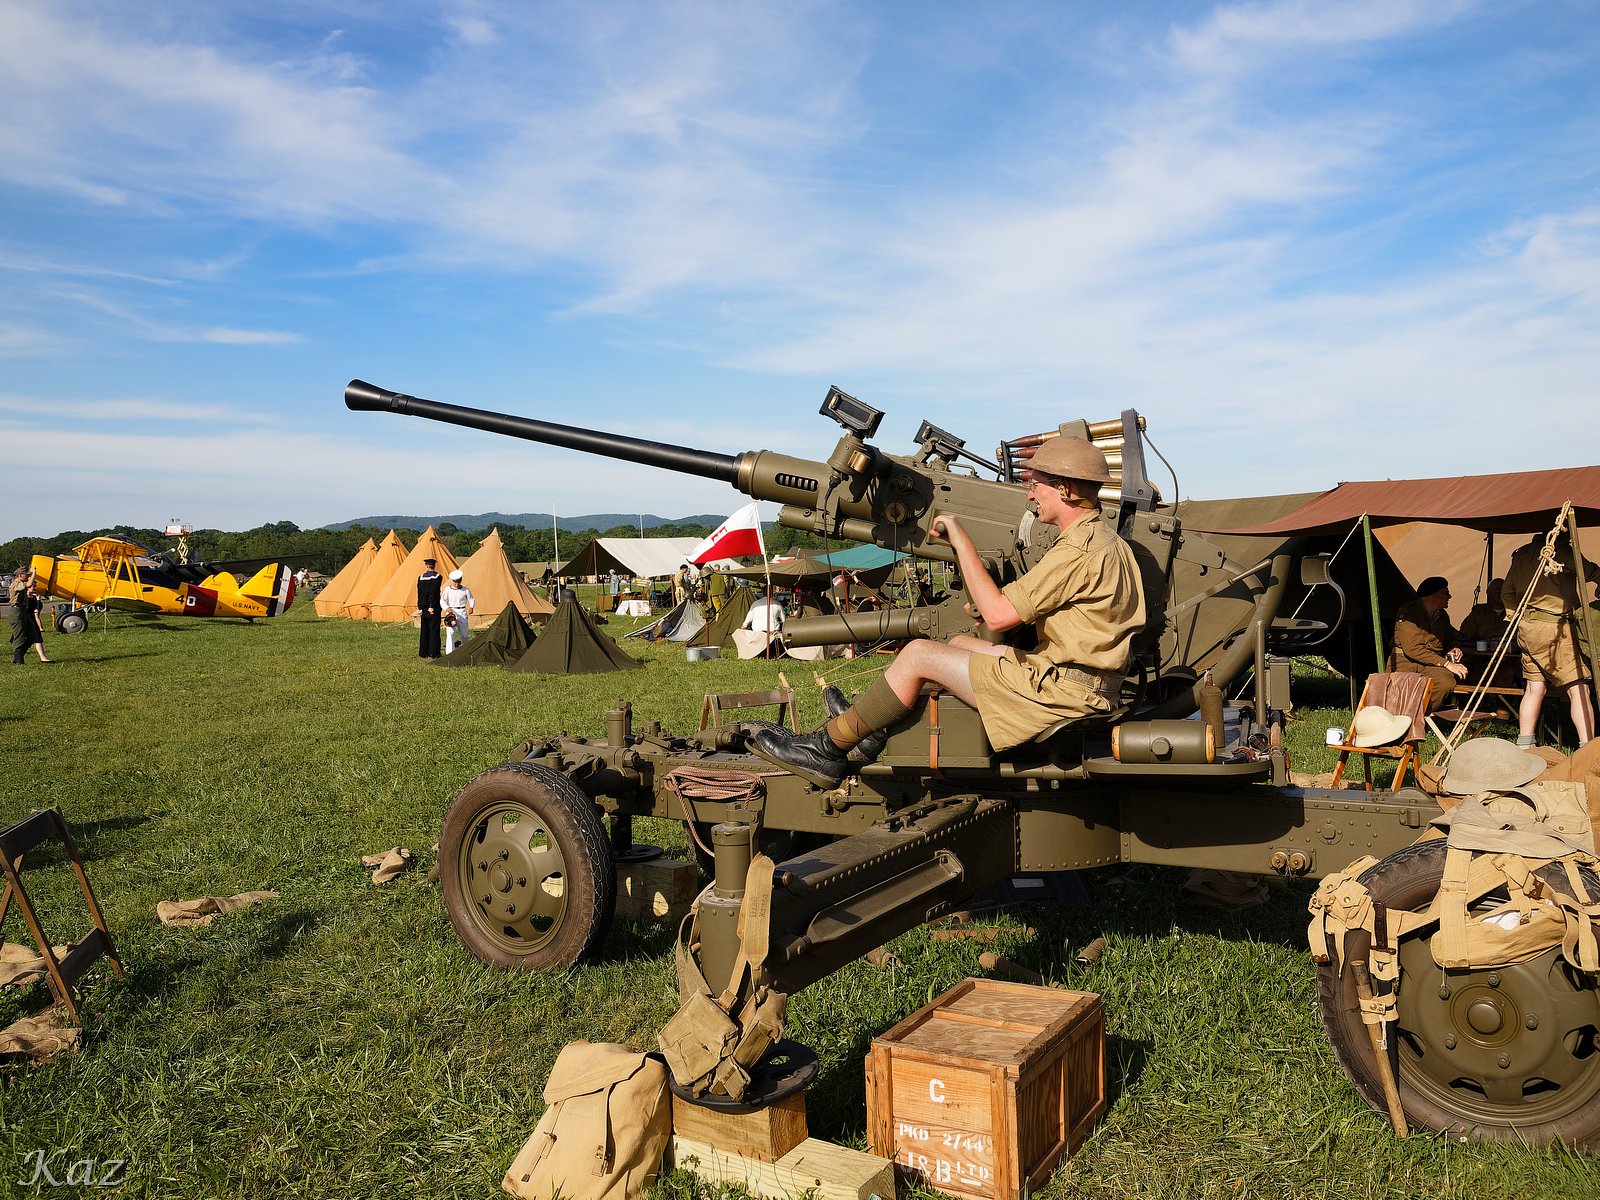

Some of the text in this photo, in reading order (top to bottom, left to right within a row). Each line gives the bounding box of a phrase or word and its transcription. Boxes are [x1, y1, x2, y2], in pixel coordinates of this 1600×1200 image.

[929, 1079, 945, 1103] C
[899, 1123, 984, 1153] PKD 2/44
